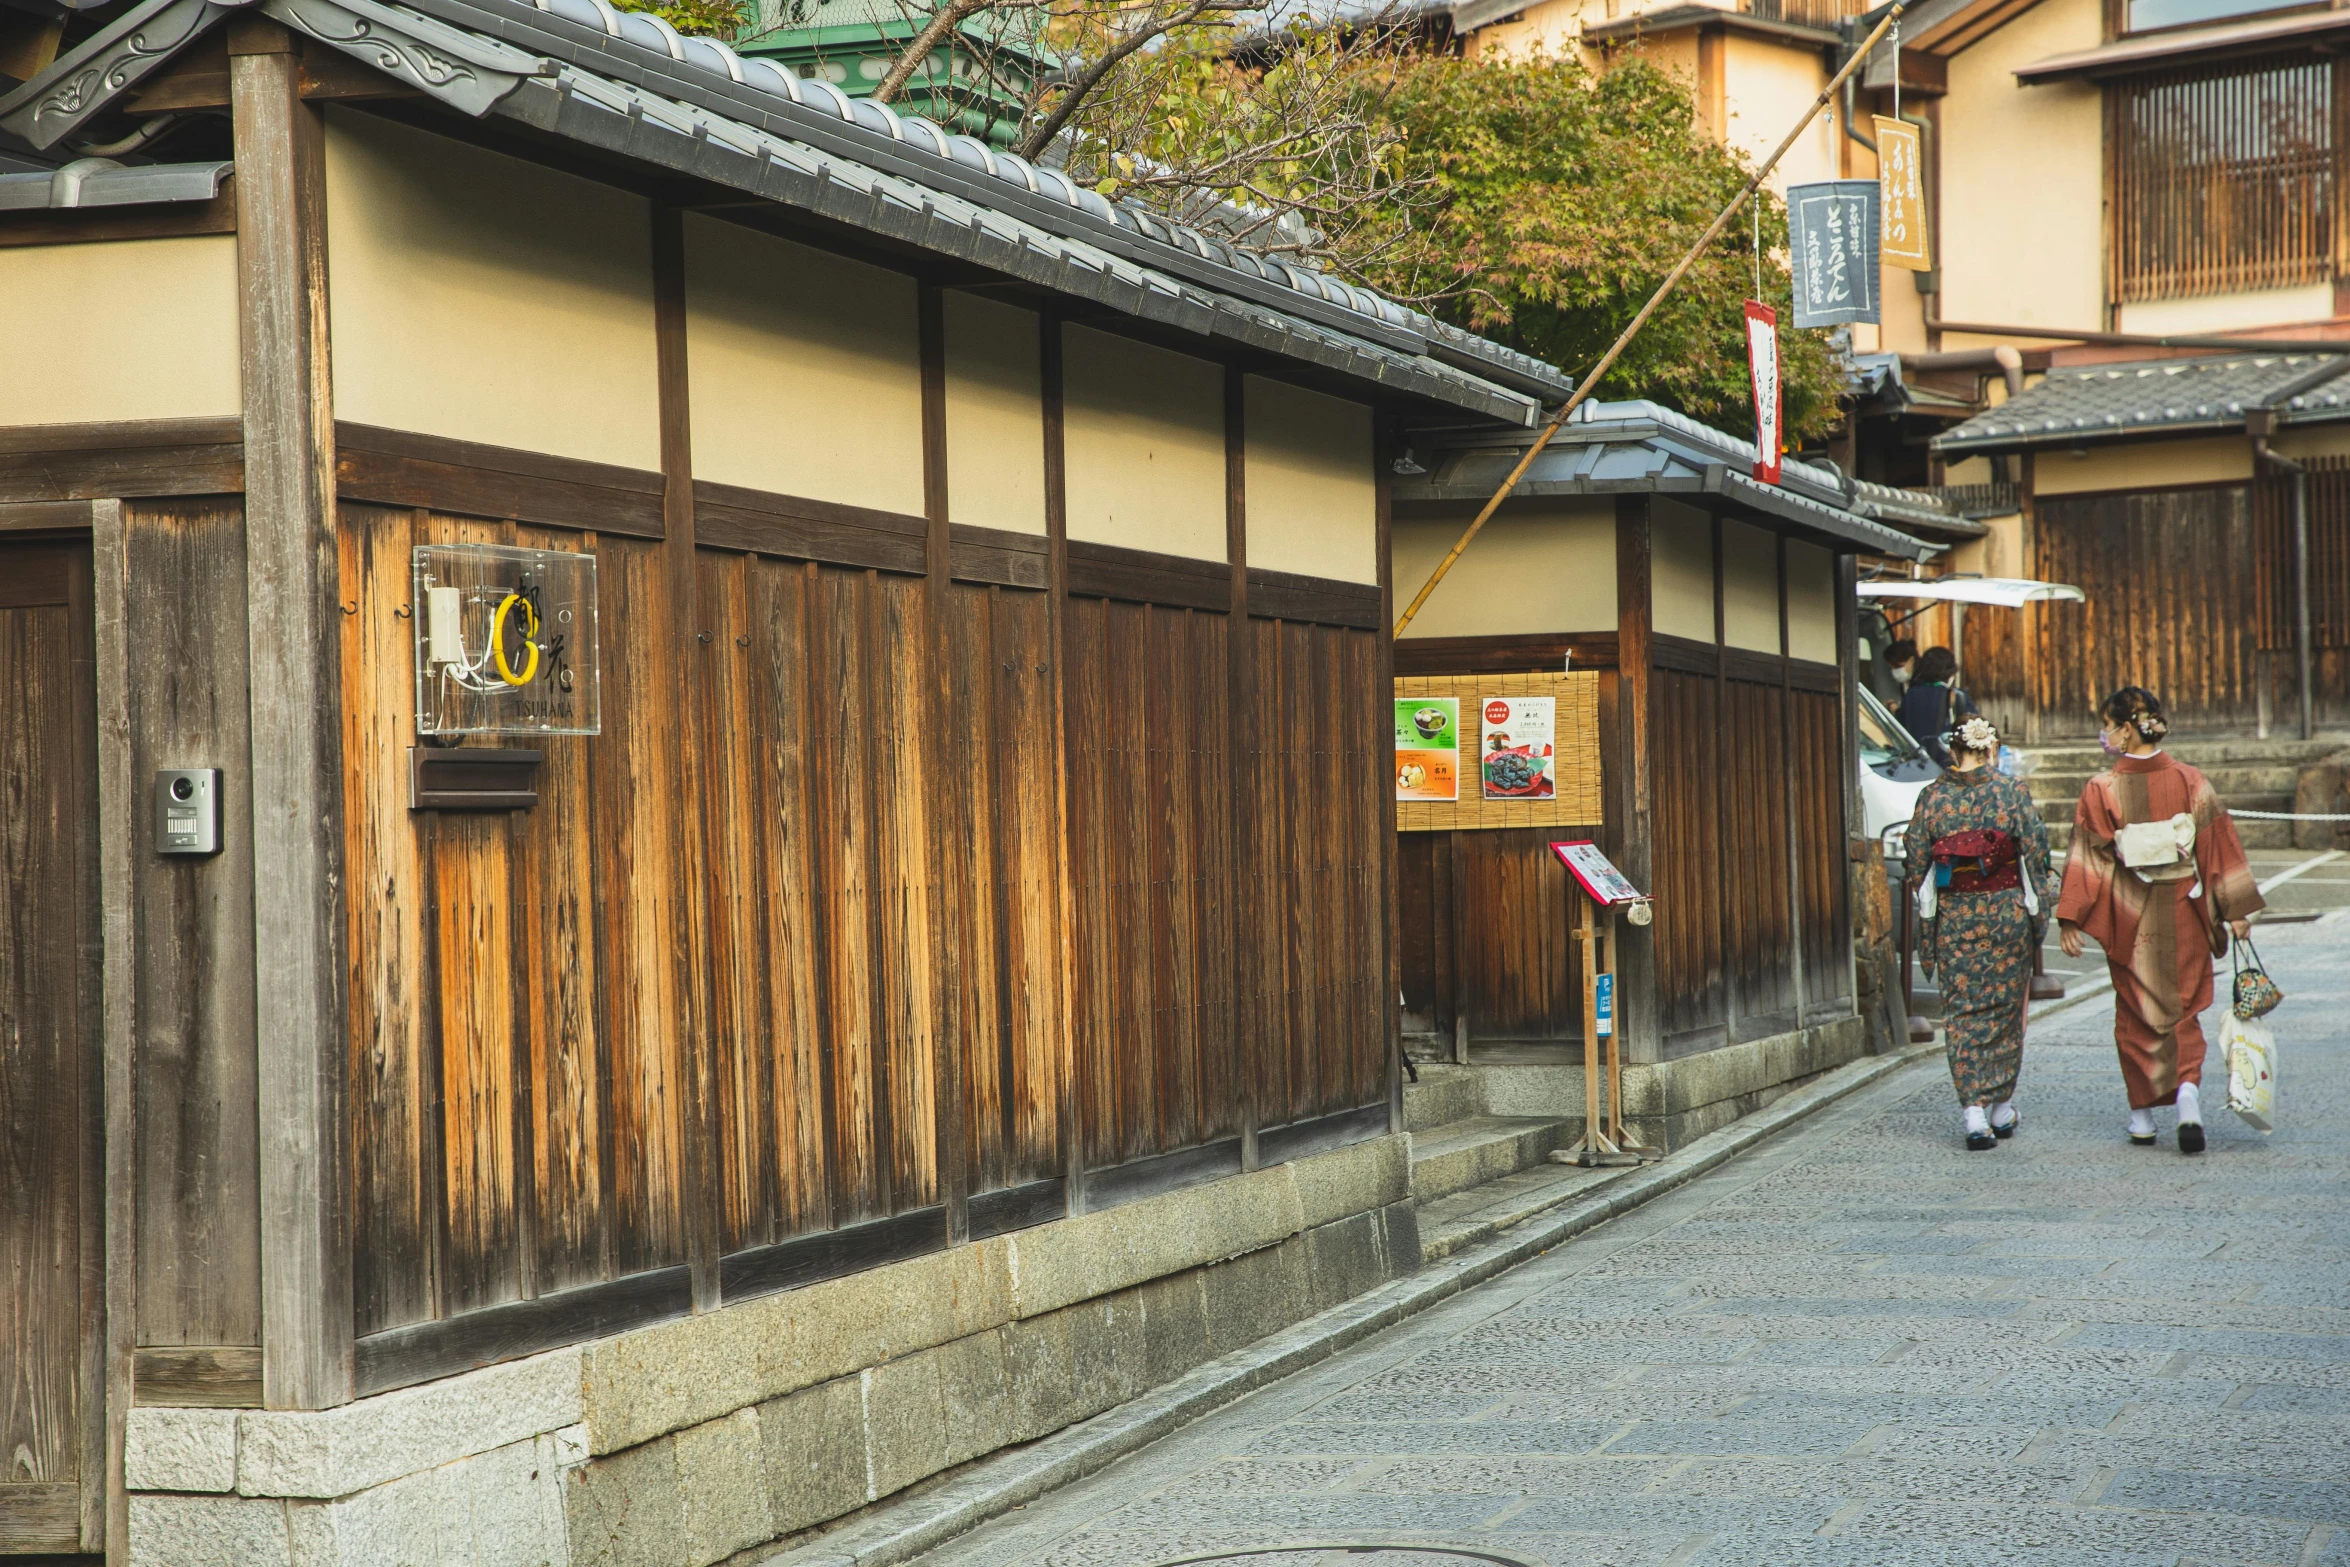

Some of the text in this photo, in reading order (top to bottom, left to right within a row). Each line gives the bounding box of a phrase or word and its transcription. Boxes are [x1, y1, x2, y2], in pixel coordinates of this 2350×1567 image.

[1893, 139, 1906, 242] あんみつ
[1827, 204, 1850, 303] ところてん
[1848, 203, 1862, 258] 京甘味
[515, 700, 574, 718] TSUHANA
